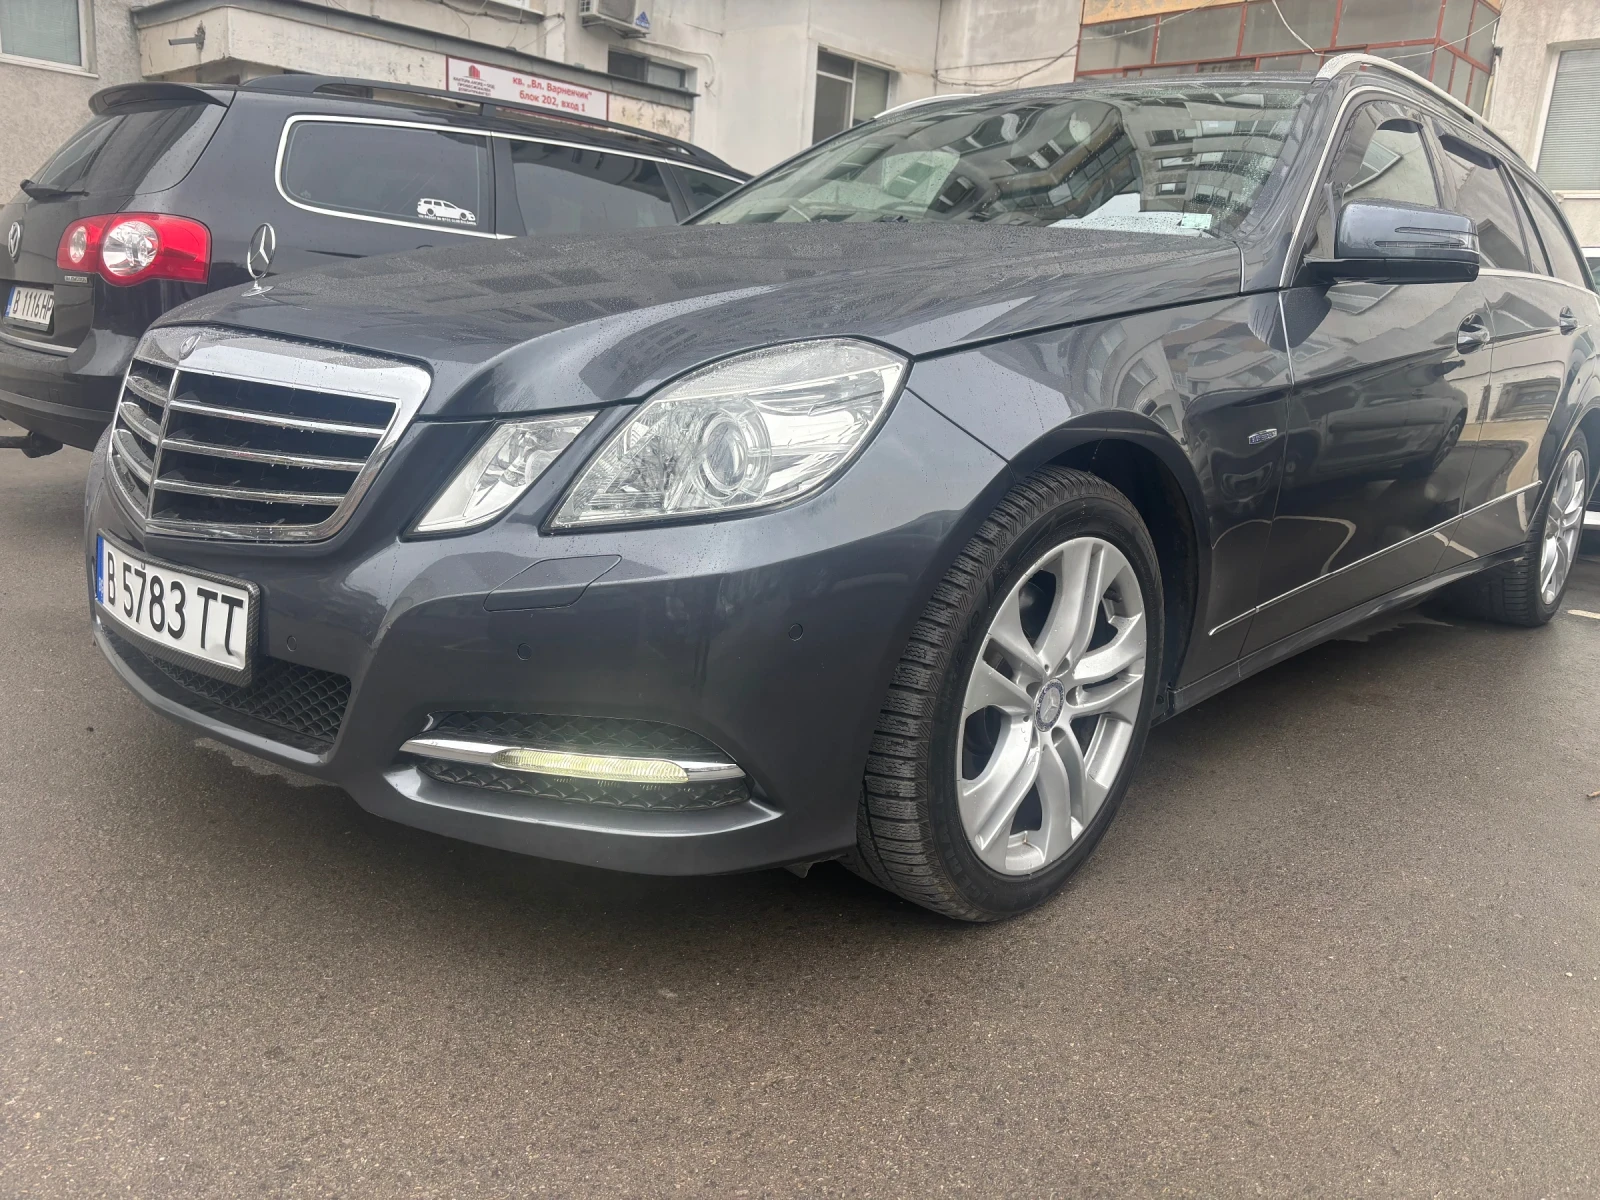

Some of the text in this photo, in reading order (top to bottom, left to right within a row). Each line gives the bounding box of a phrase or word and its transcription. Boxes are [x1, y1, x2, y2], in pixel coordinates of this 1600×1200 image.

[512, 77, 525, 87] кв.
[519, 90, 586, 112] блок 202, вход 1
[13, 290, 21, 314] B
[22, 291, 42, 317] 1116
[107, 551, 244, 656] B 5783 TT
